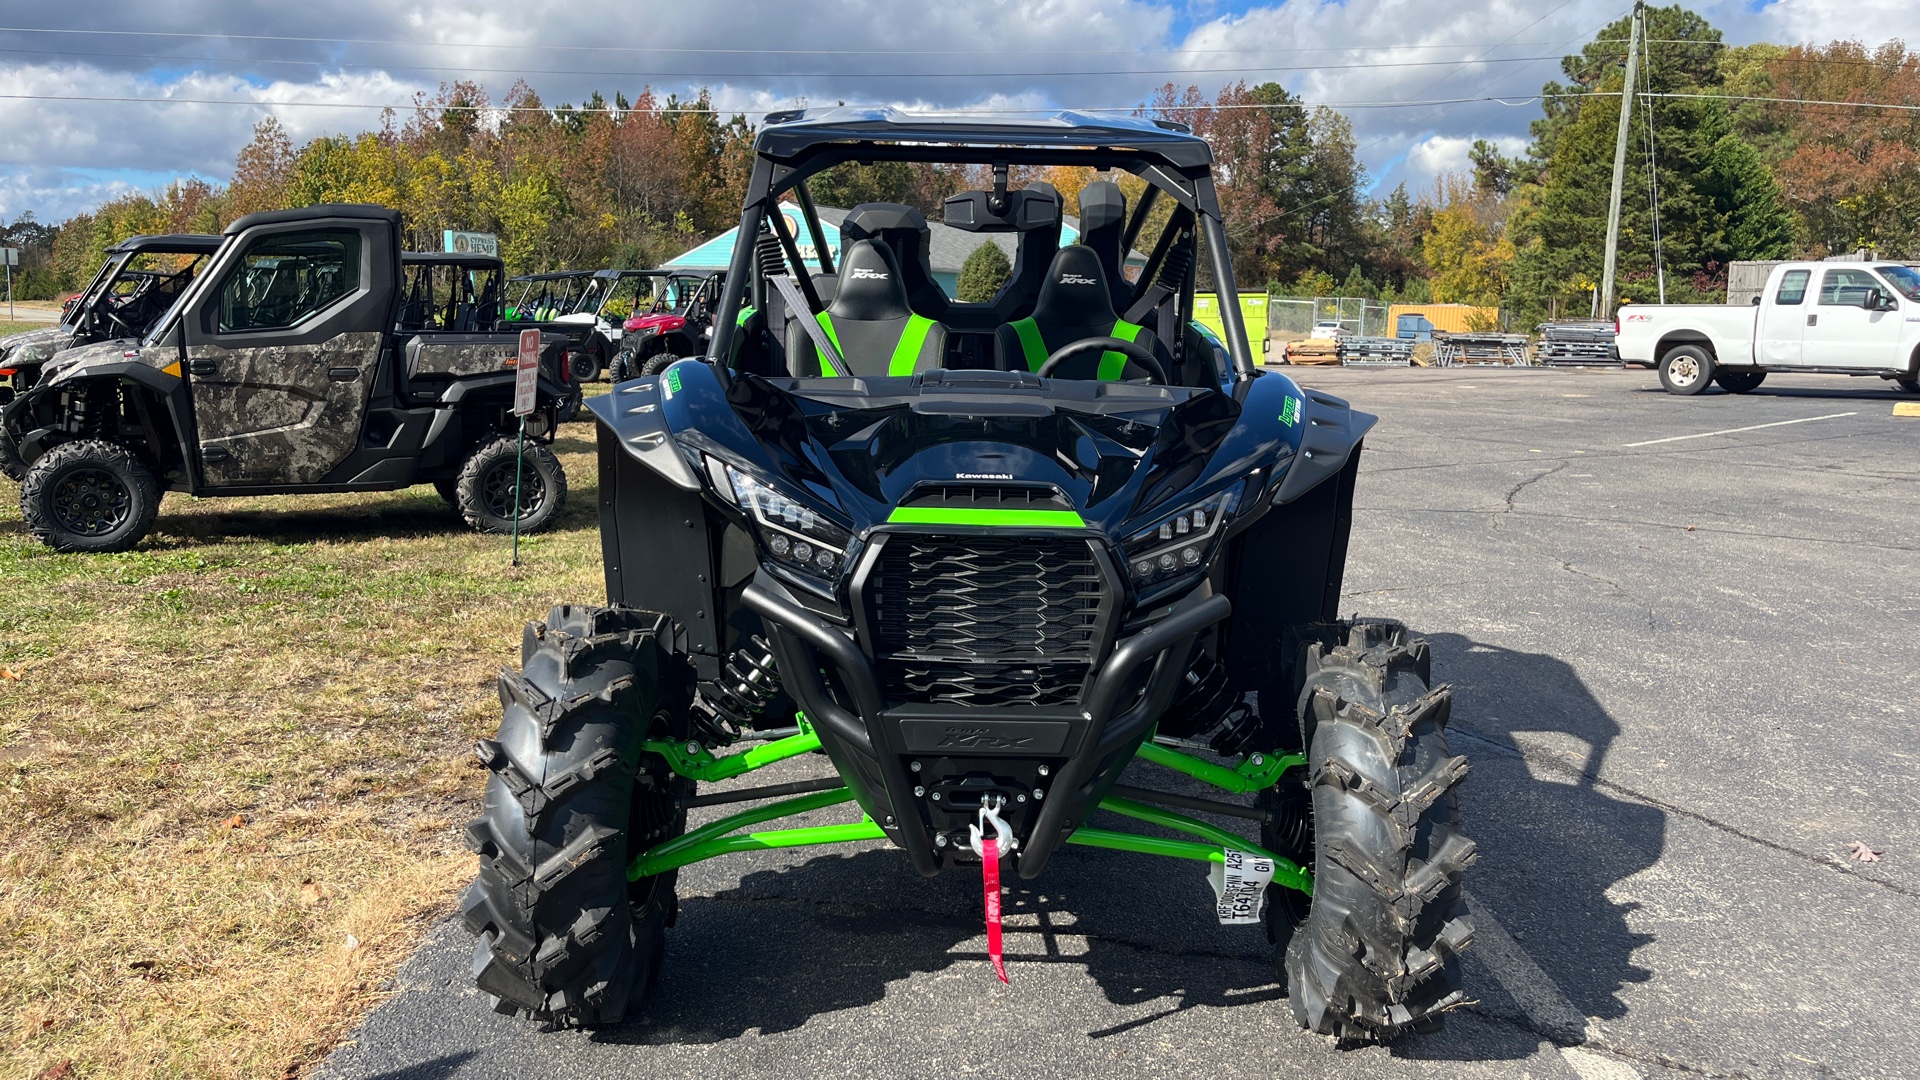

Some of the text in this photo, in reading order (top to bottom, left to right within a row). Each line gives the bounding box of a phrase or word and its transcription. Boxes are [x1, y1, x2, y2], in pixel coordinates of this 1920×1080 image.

[470, 236, 495, 245] CYPRESS
[470, 243, 495, 254] HEMP
[798, 244, 838, 260] HEP
[850, 272, 889, 280] KRX
[1059, 277, 1097, 285] KRX
[525, 335, 534, 350] NO
[520, 350, 538, 366] PARKING
[955, 472, 1014, 480] Kawasaki
[936, 735, 1035, 749] KRX
[986, 890, 1000, 924] WARN
[1231, 880, 1261, 920] T64704
